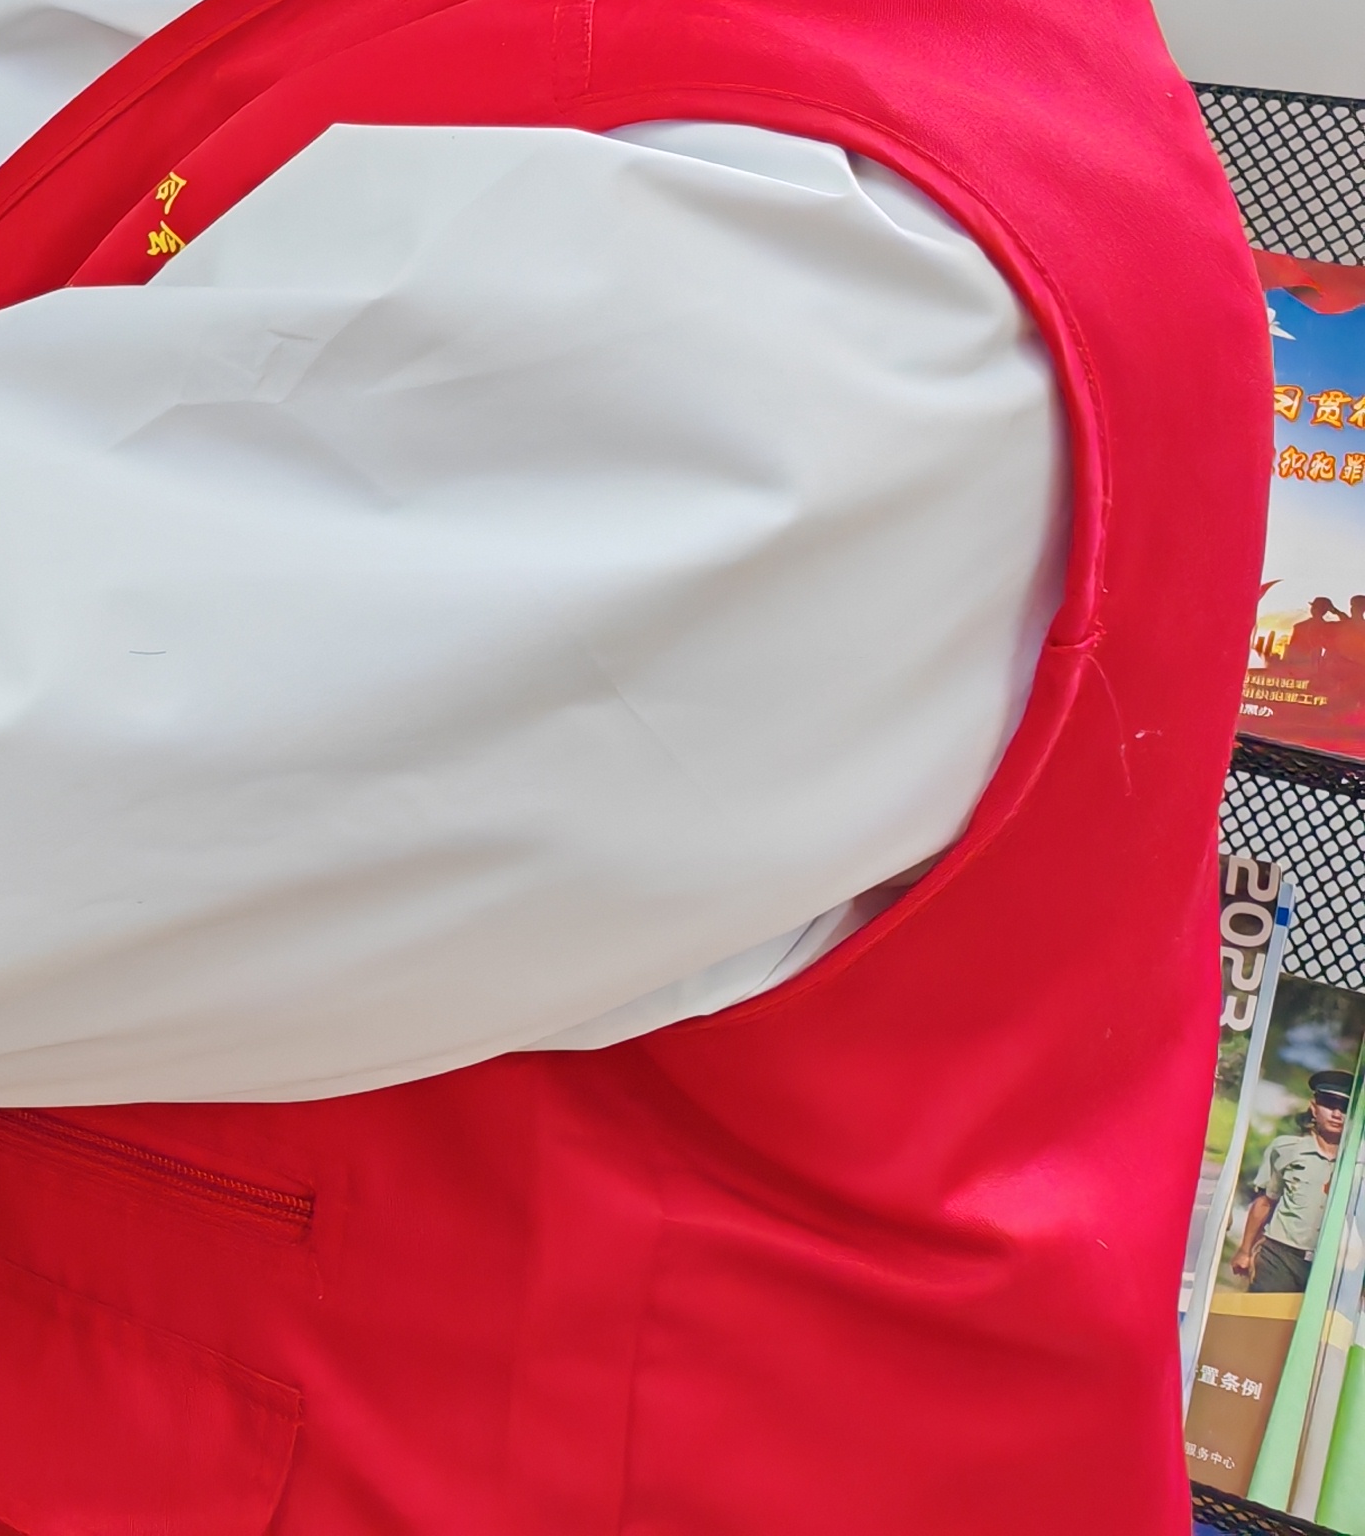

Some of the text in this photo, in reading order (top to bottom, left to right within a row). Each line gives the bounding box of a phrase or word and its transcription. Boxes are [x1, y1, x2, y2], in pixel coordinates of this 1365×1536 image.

[1271, 445, 1365, 485] 织犯罪
[1195, 1364, 1263, 1400] 置条例
